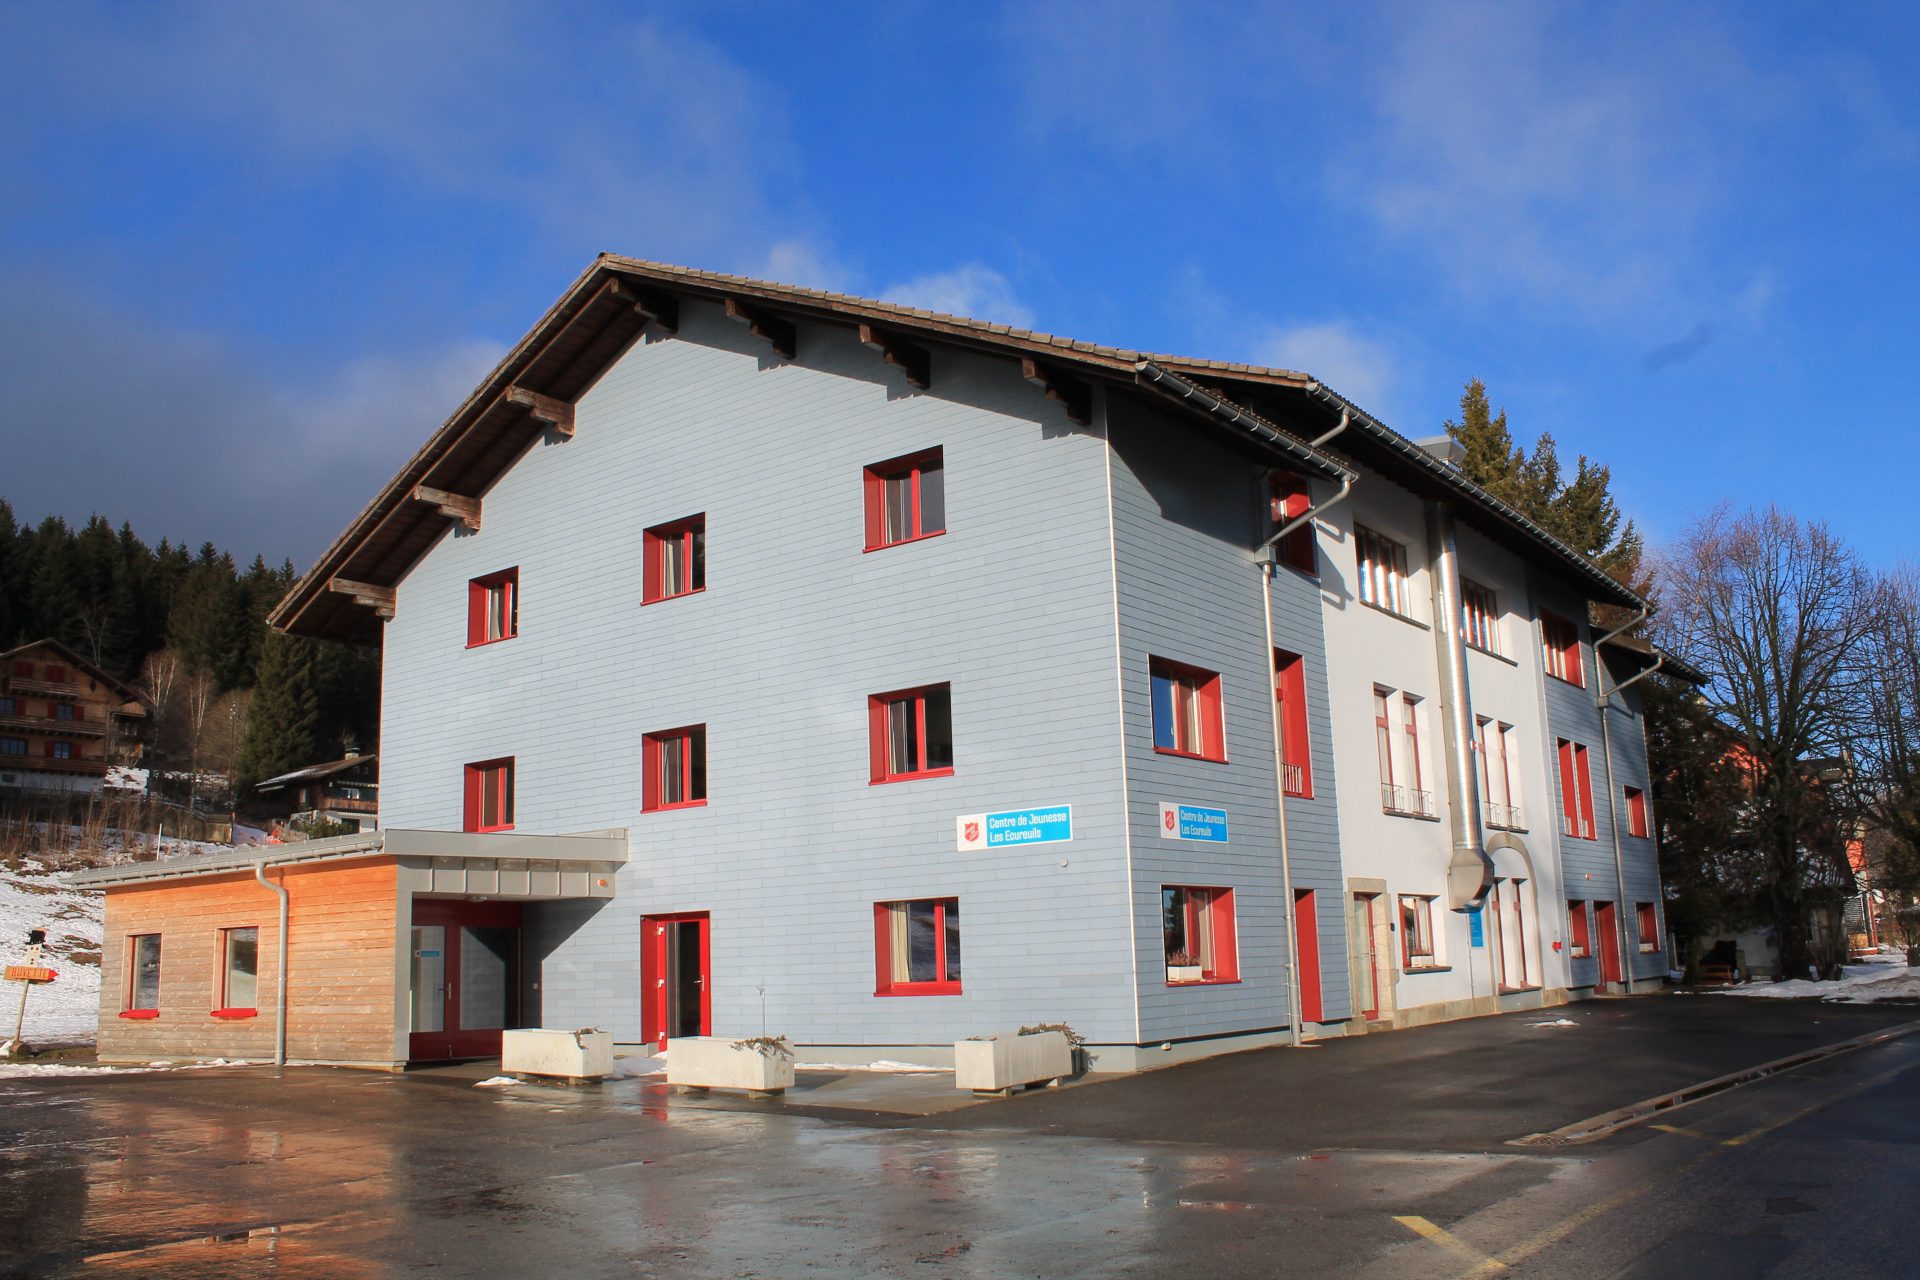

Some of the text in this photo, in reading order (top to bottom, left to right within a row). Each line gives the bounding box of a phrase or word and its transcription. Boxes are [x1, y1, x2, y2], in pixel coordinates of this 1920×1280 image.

[989, 812, 1067, 829] Centre de Jeunesse
[1180, 810, 1197, 821] Centre
[1197, 812, 1203, 822] de
[989, 832, 1002, 843] Les
[1005, 828, 1041, 841] Ecureuils
[11, 967, 48, 979] BUVETTE
